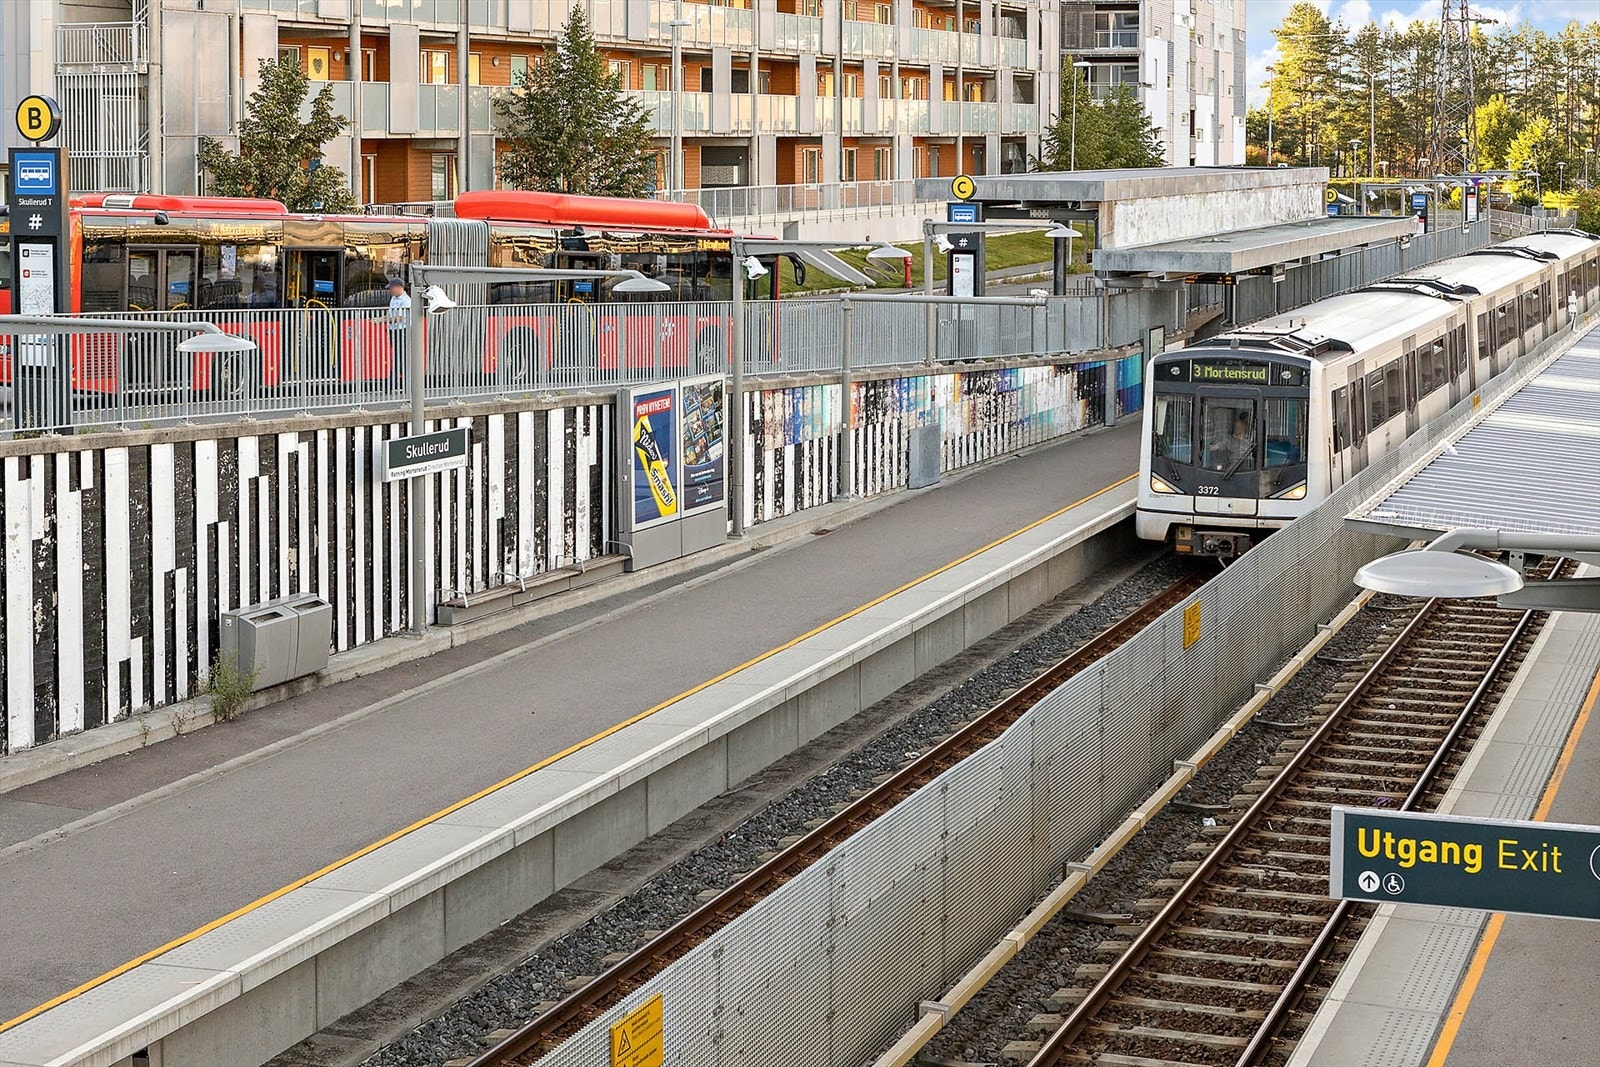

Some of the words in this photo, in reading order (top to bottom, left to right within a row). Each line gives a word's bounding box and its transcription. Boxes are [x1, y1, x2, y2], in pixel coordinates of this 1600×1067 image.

[28, 107, 42, 130] B
[957, 181, 966, 193] C
[18, 198, 47, 206] Skullerud
[48, 198, 53, 206] T
[1193, 364, 1201, 377] 3
[1204, 366, 1266, 380] Mortensrud
[406, 438, 449, 459] Skullerud
[650, 468, 673, 507] Smash!
[1198, 485, 1219, 495] 3372
[1357, 827, 1483, 874] Utgang
[1498, 839, 1563, 874] Exit
